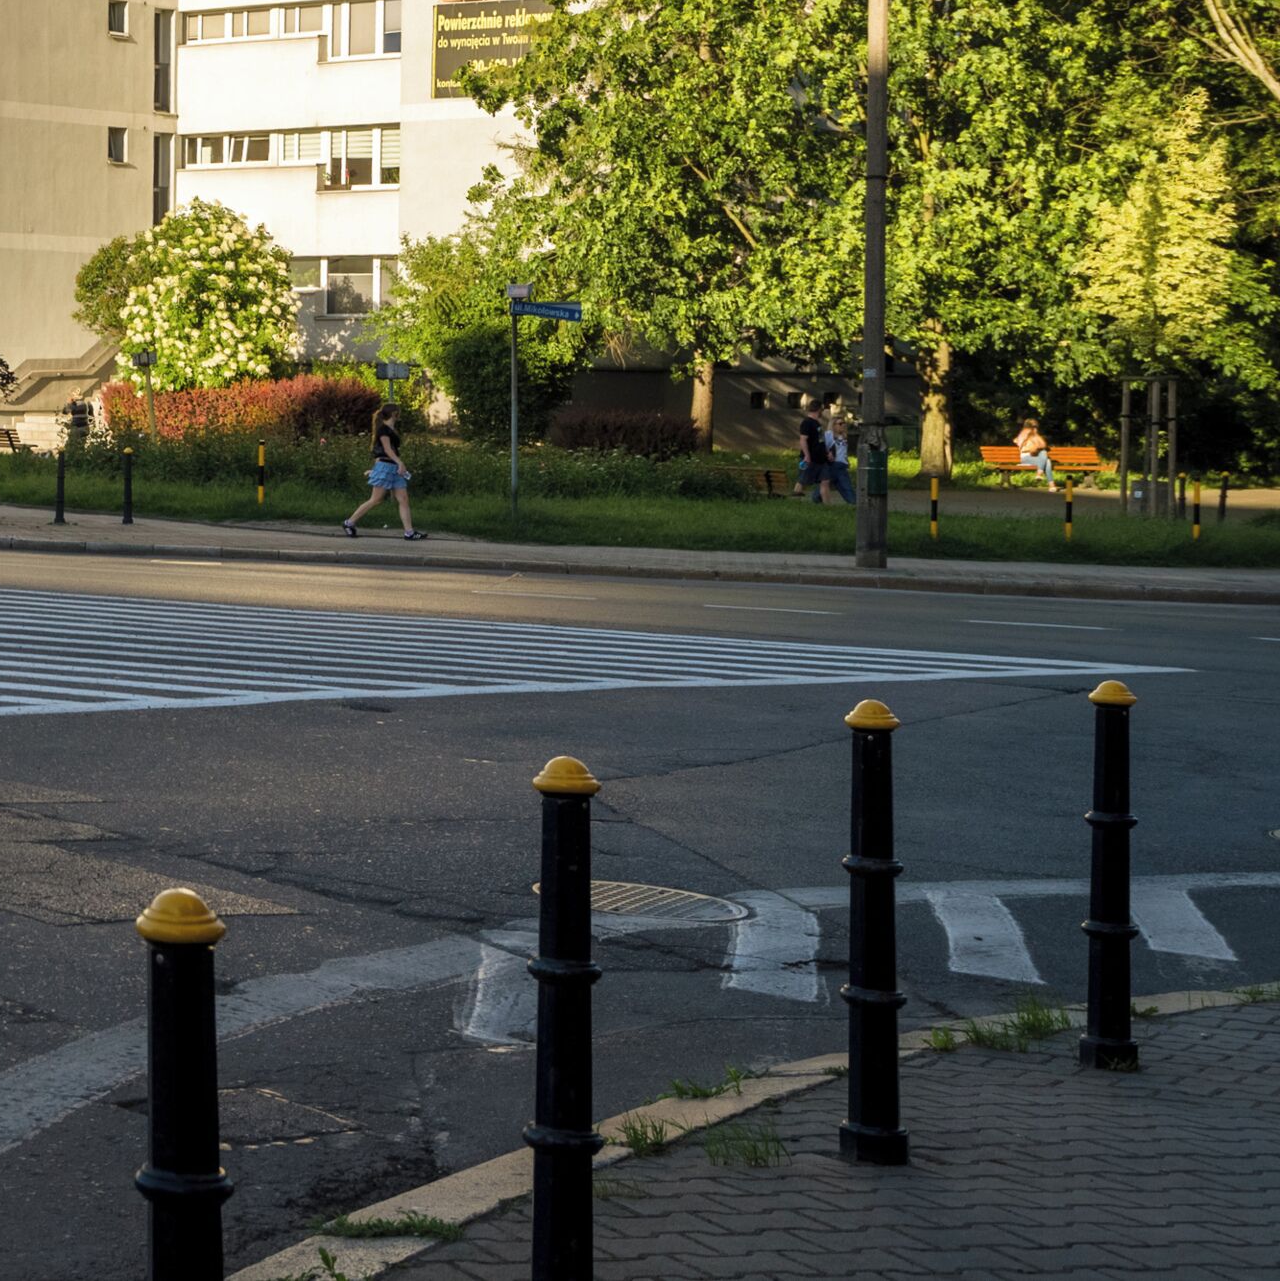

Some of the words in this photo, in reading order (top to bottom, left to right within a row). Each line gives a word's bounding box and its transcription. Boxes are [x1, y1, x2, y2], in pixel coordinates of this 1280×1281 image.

[438, 10, 503, 32] Powierzchnie
[438, 36, 448, 48] do
[450, 34, 490, 50] wynajęcia
[492, 37, 500, 46] w
